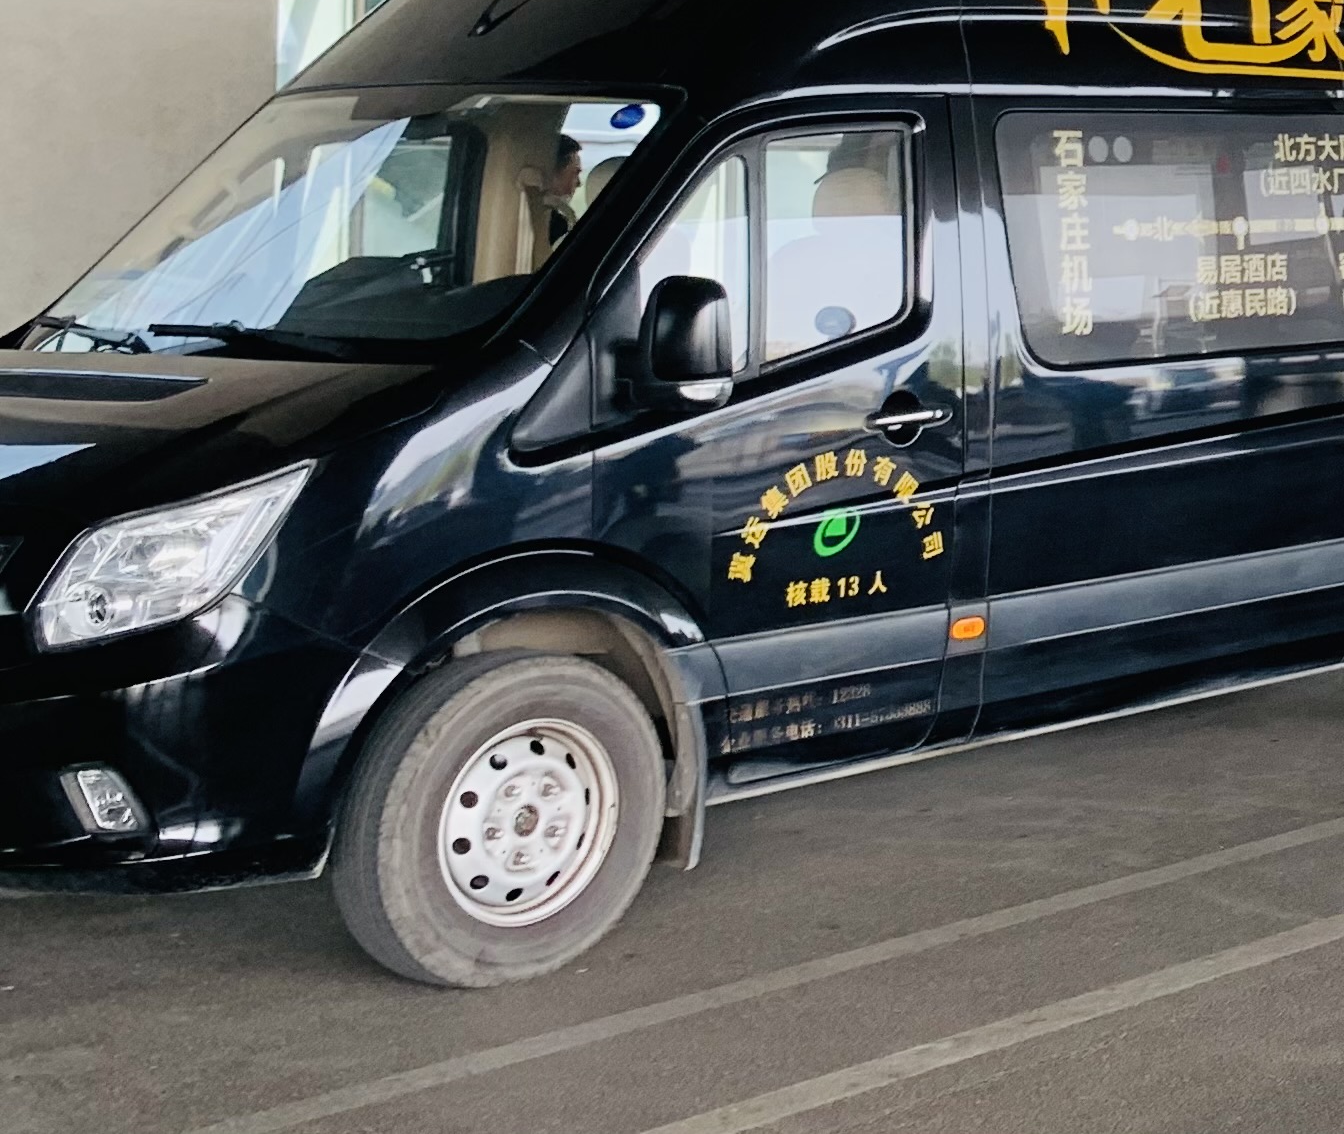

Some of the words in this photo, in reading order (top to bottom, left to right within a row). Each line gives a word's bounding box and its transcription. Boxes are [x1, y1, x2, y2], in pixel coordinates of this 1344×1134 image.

[1053, 130, 1094, 336] 石家庄机场
[1196, 252, 1288, 285] 易居酒店
